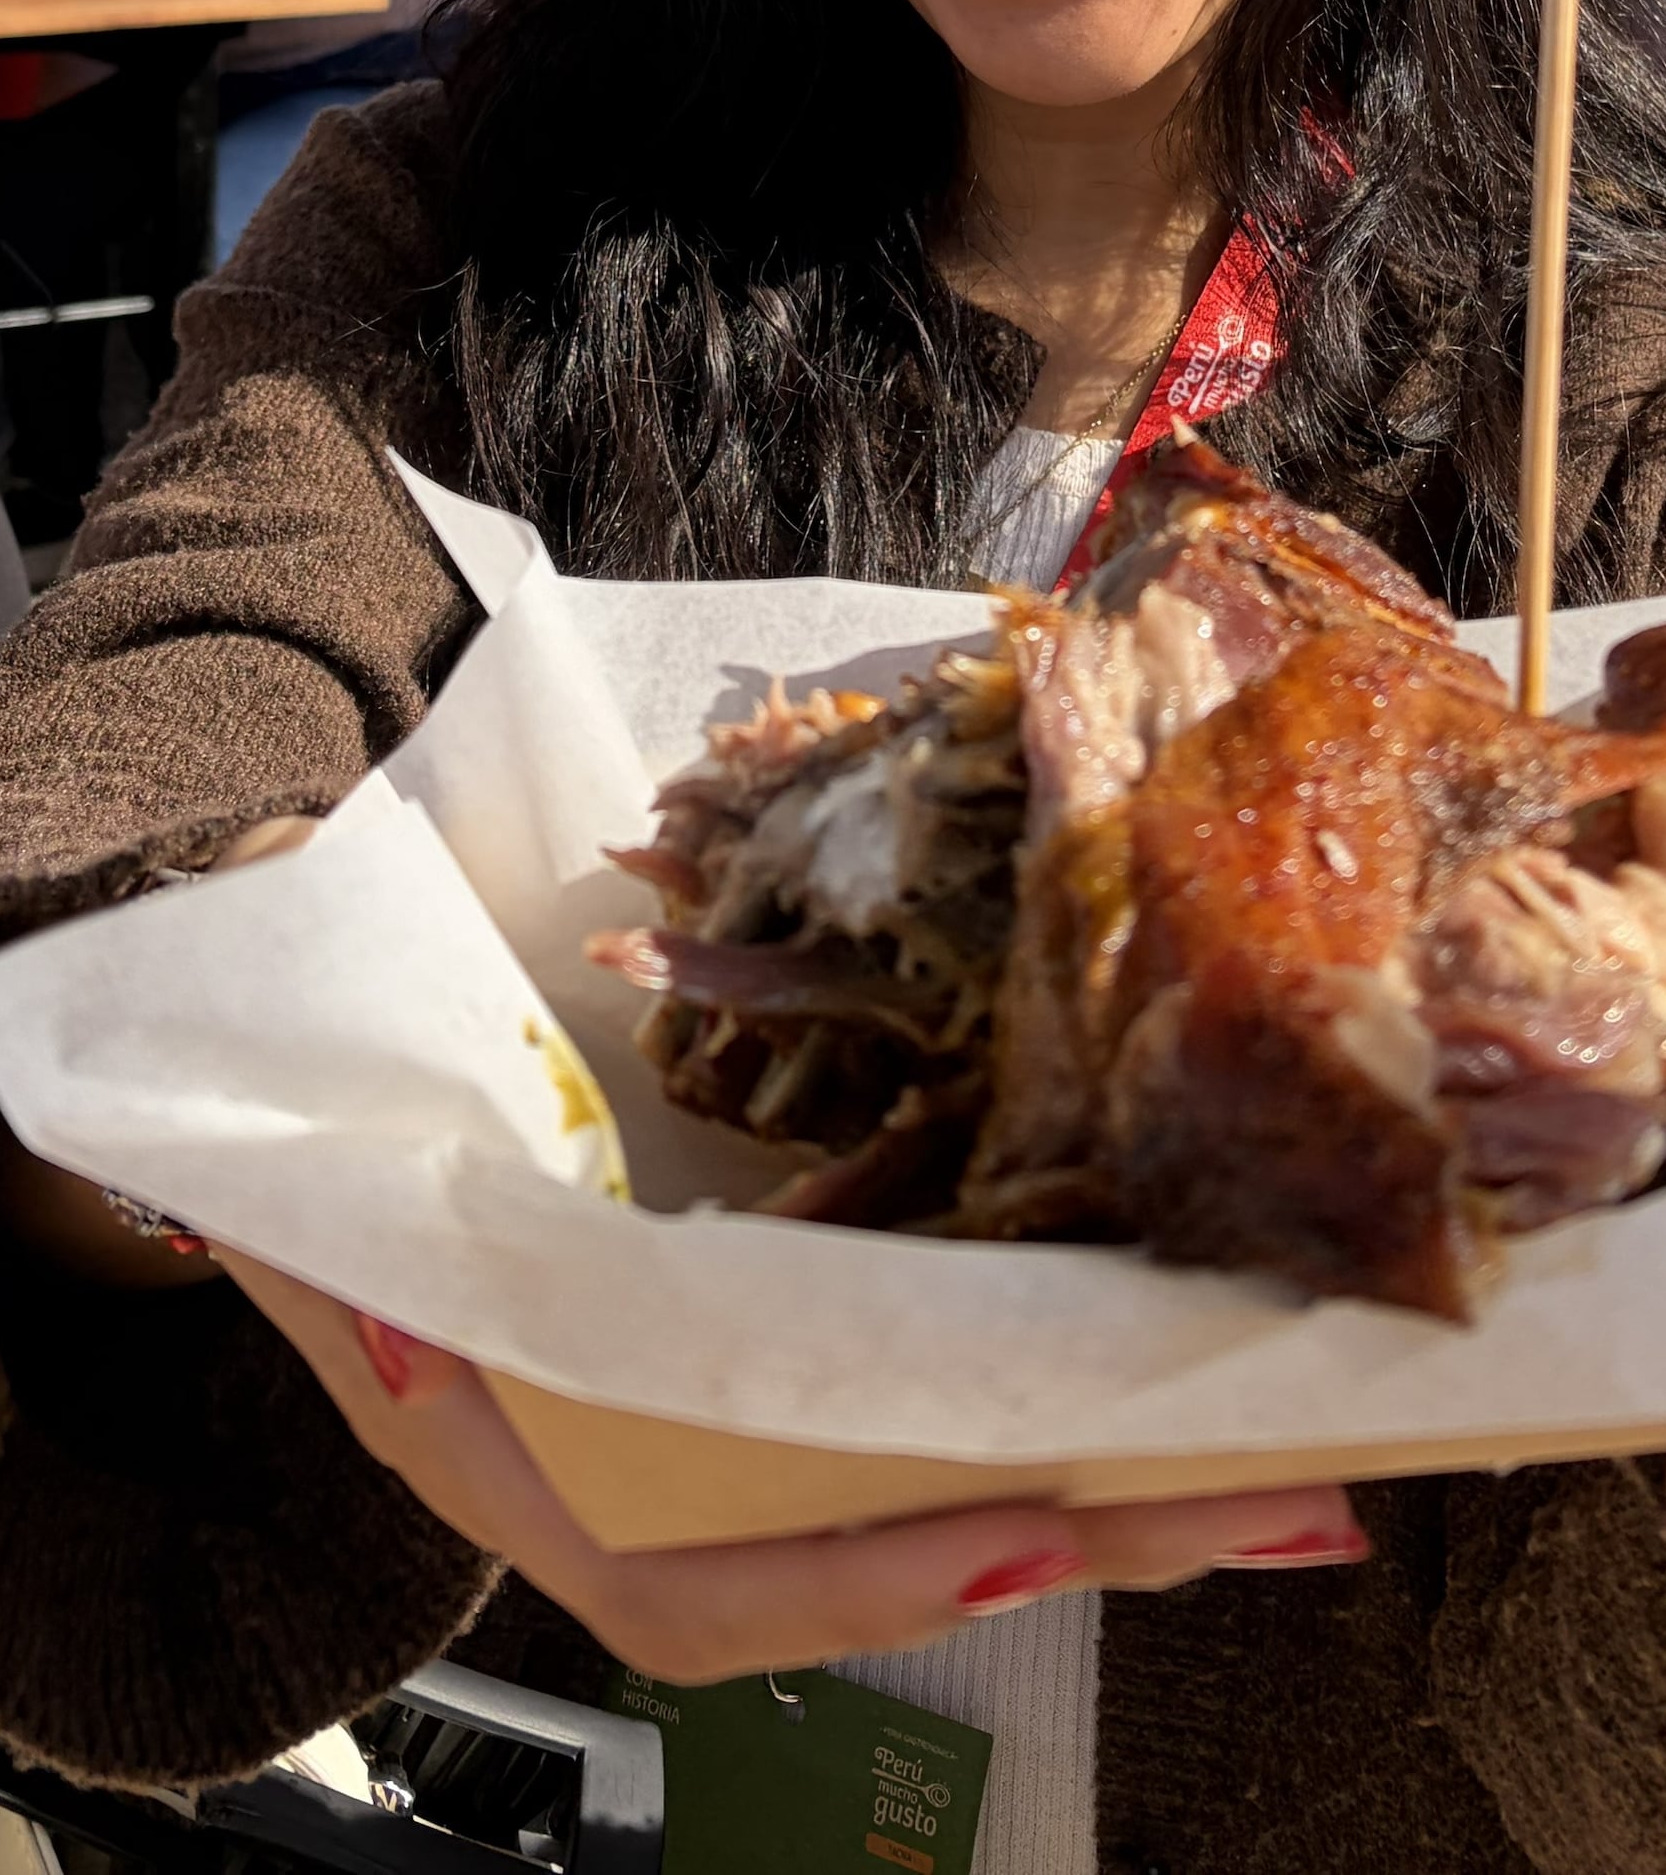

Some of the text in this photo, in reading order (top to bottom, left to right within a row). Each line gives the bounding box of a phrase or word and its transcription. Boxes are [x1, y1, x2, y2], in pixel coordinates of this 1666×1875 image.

[622, 1689, 680, 1725] HISTORIA
[874, 1745, 924, 1783] Perú
[878, 1780, 919, 1805] mucho
[873, 1796, 938, 1837] gusto
